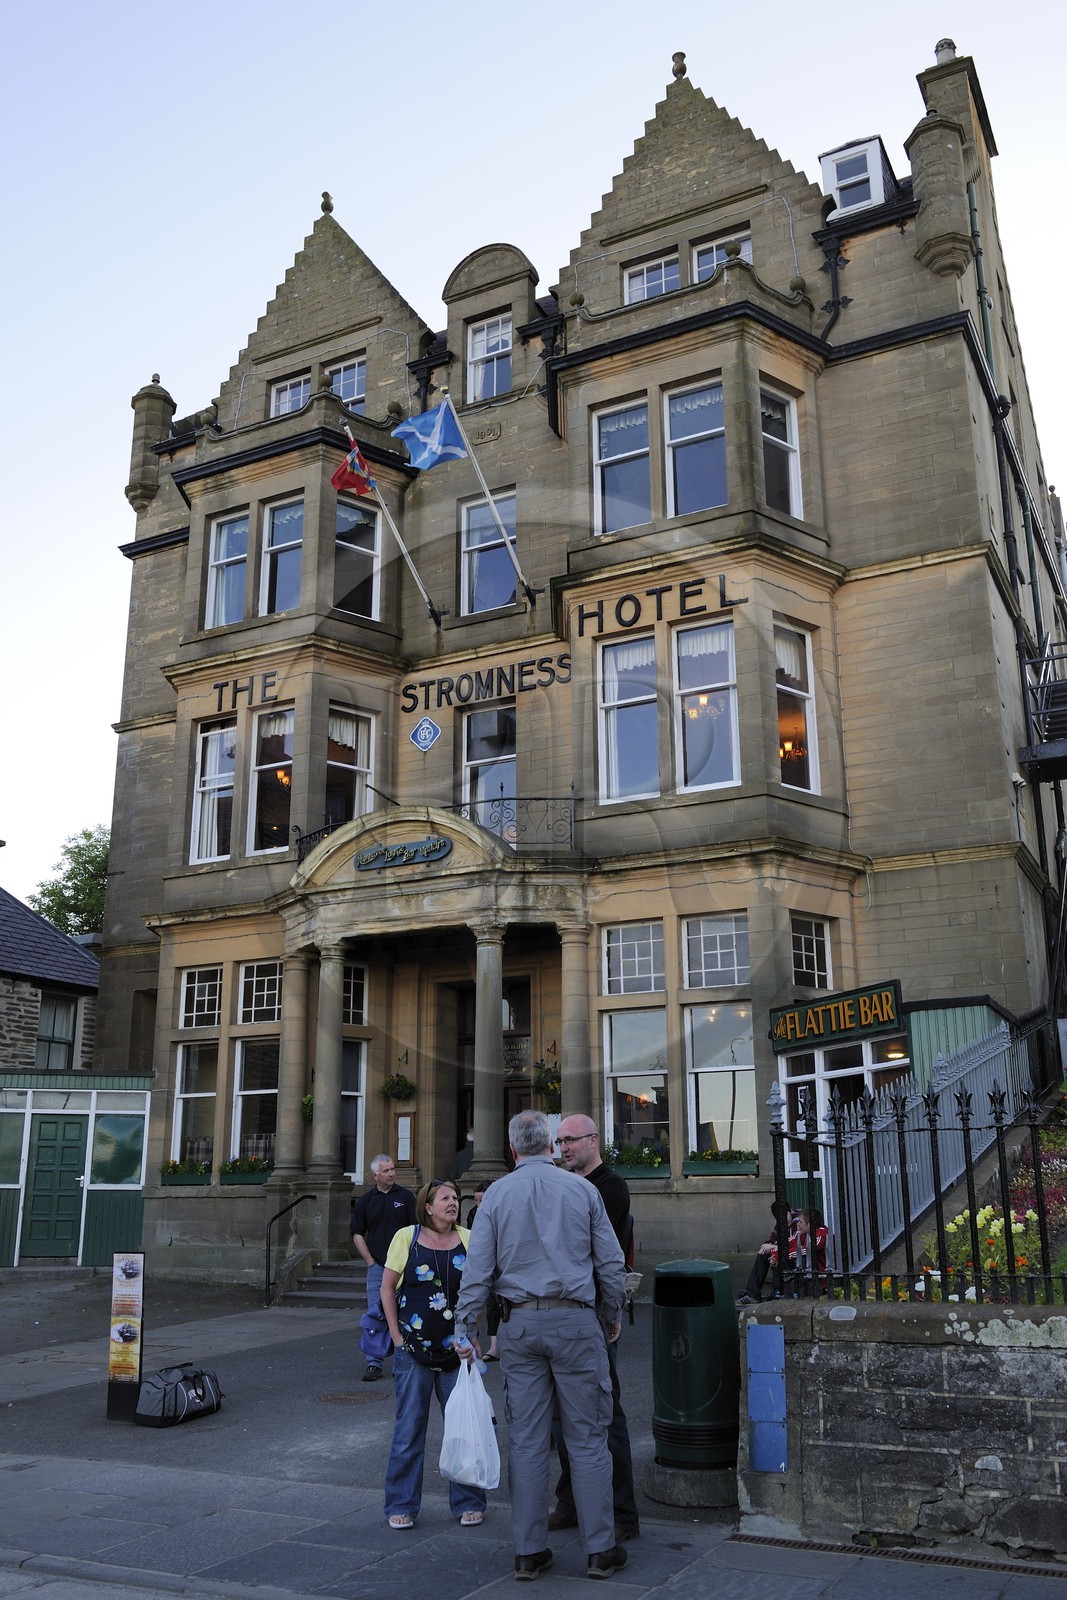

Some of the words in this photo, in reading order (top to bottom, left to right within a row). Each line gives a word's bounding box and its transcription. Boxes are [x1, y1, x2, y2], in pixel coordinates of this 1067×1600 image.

[578, 573, 749, 637] HOTEL
[213, 671, 278, 712] THE
[400, 652, 572, 713] STROMNESS
[785, 1000, 856, 1041] FLATTIE
[859, 991, 895, 1026] BAR
